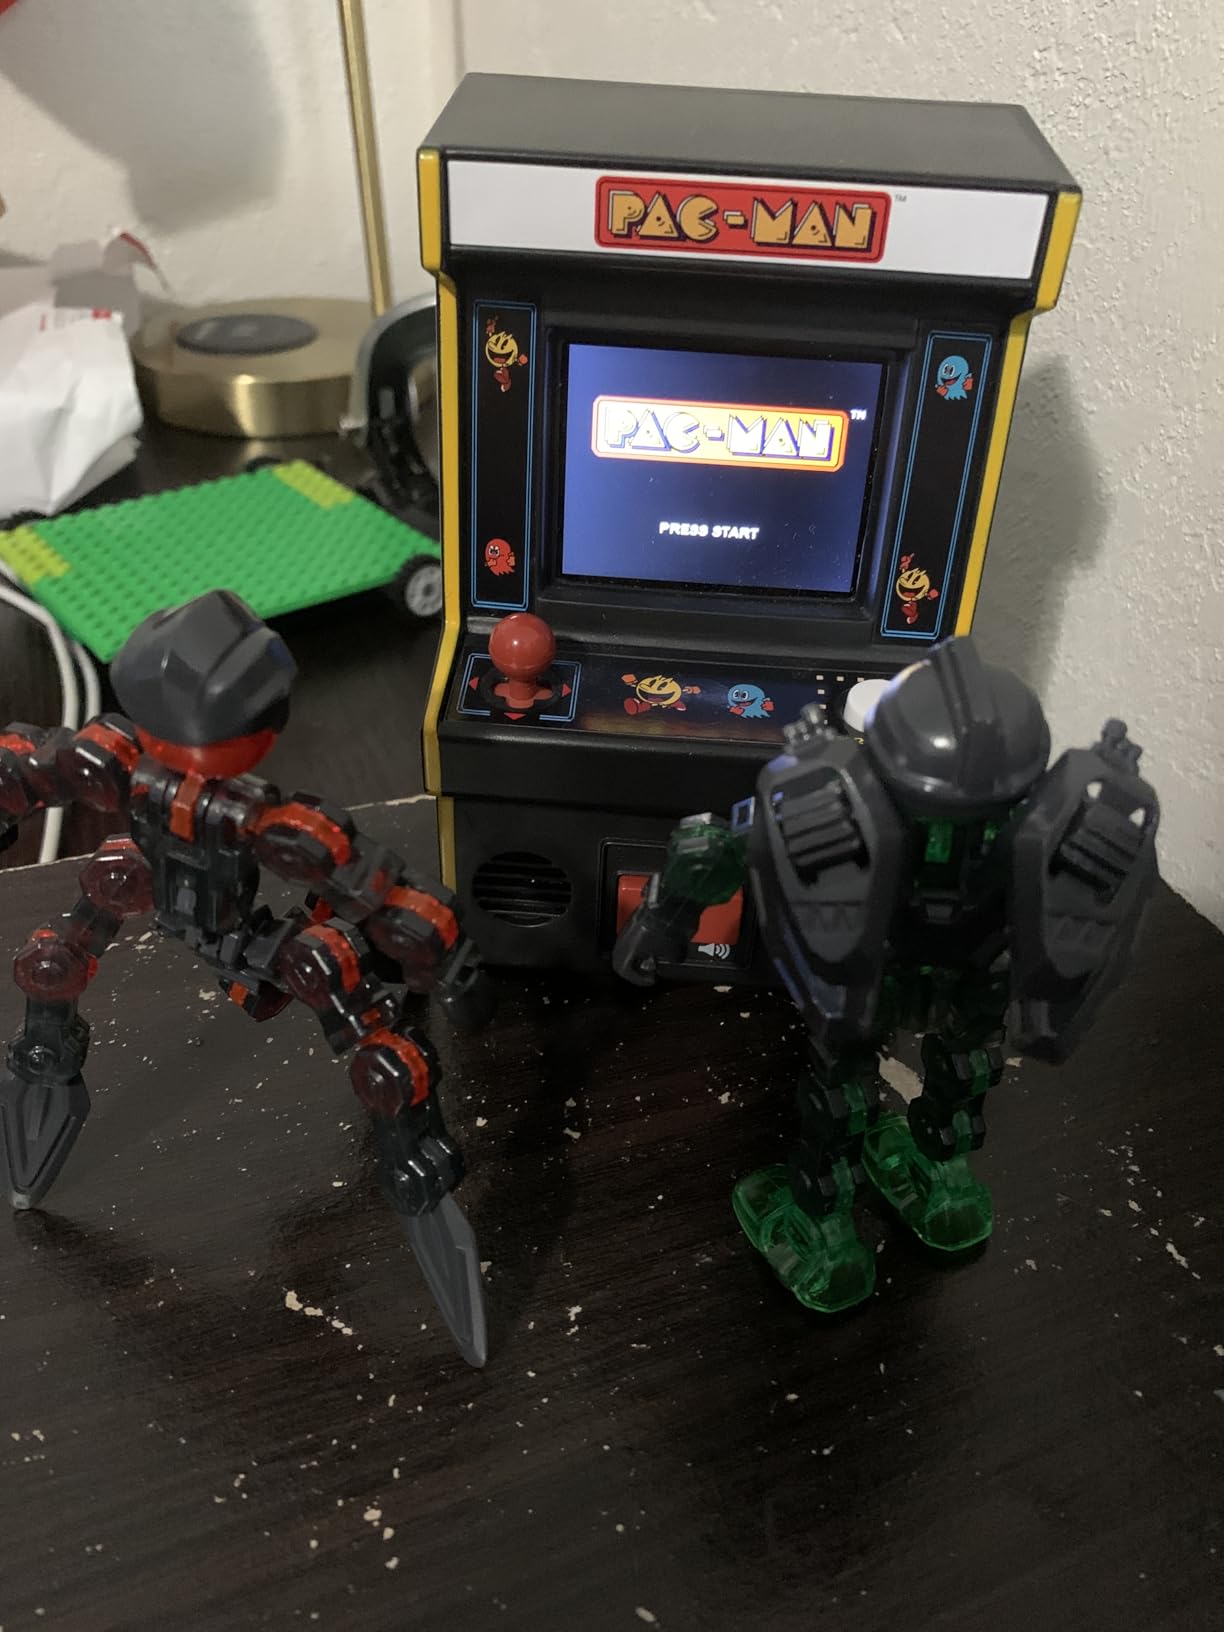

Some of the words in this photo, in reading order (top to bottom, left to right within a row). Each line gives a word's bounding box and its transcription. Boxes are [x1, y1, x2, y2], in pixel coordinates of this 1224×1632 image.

[608, 190, 877, 254] PAC-MAN
[604, 405, 835, 462] PAC-MAN
[658, 521, 709, 537] PRESS
[711, 525, 760, 540] START
